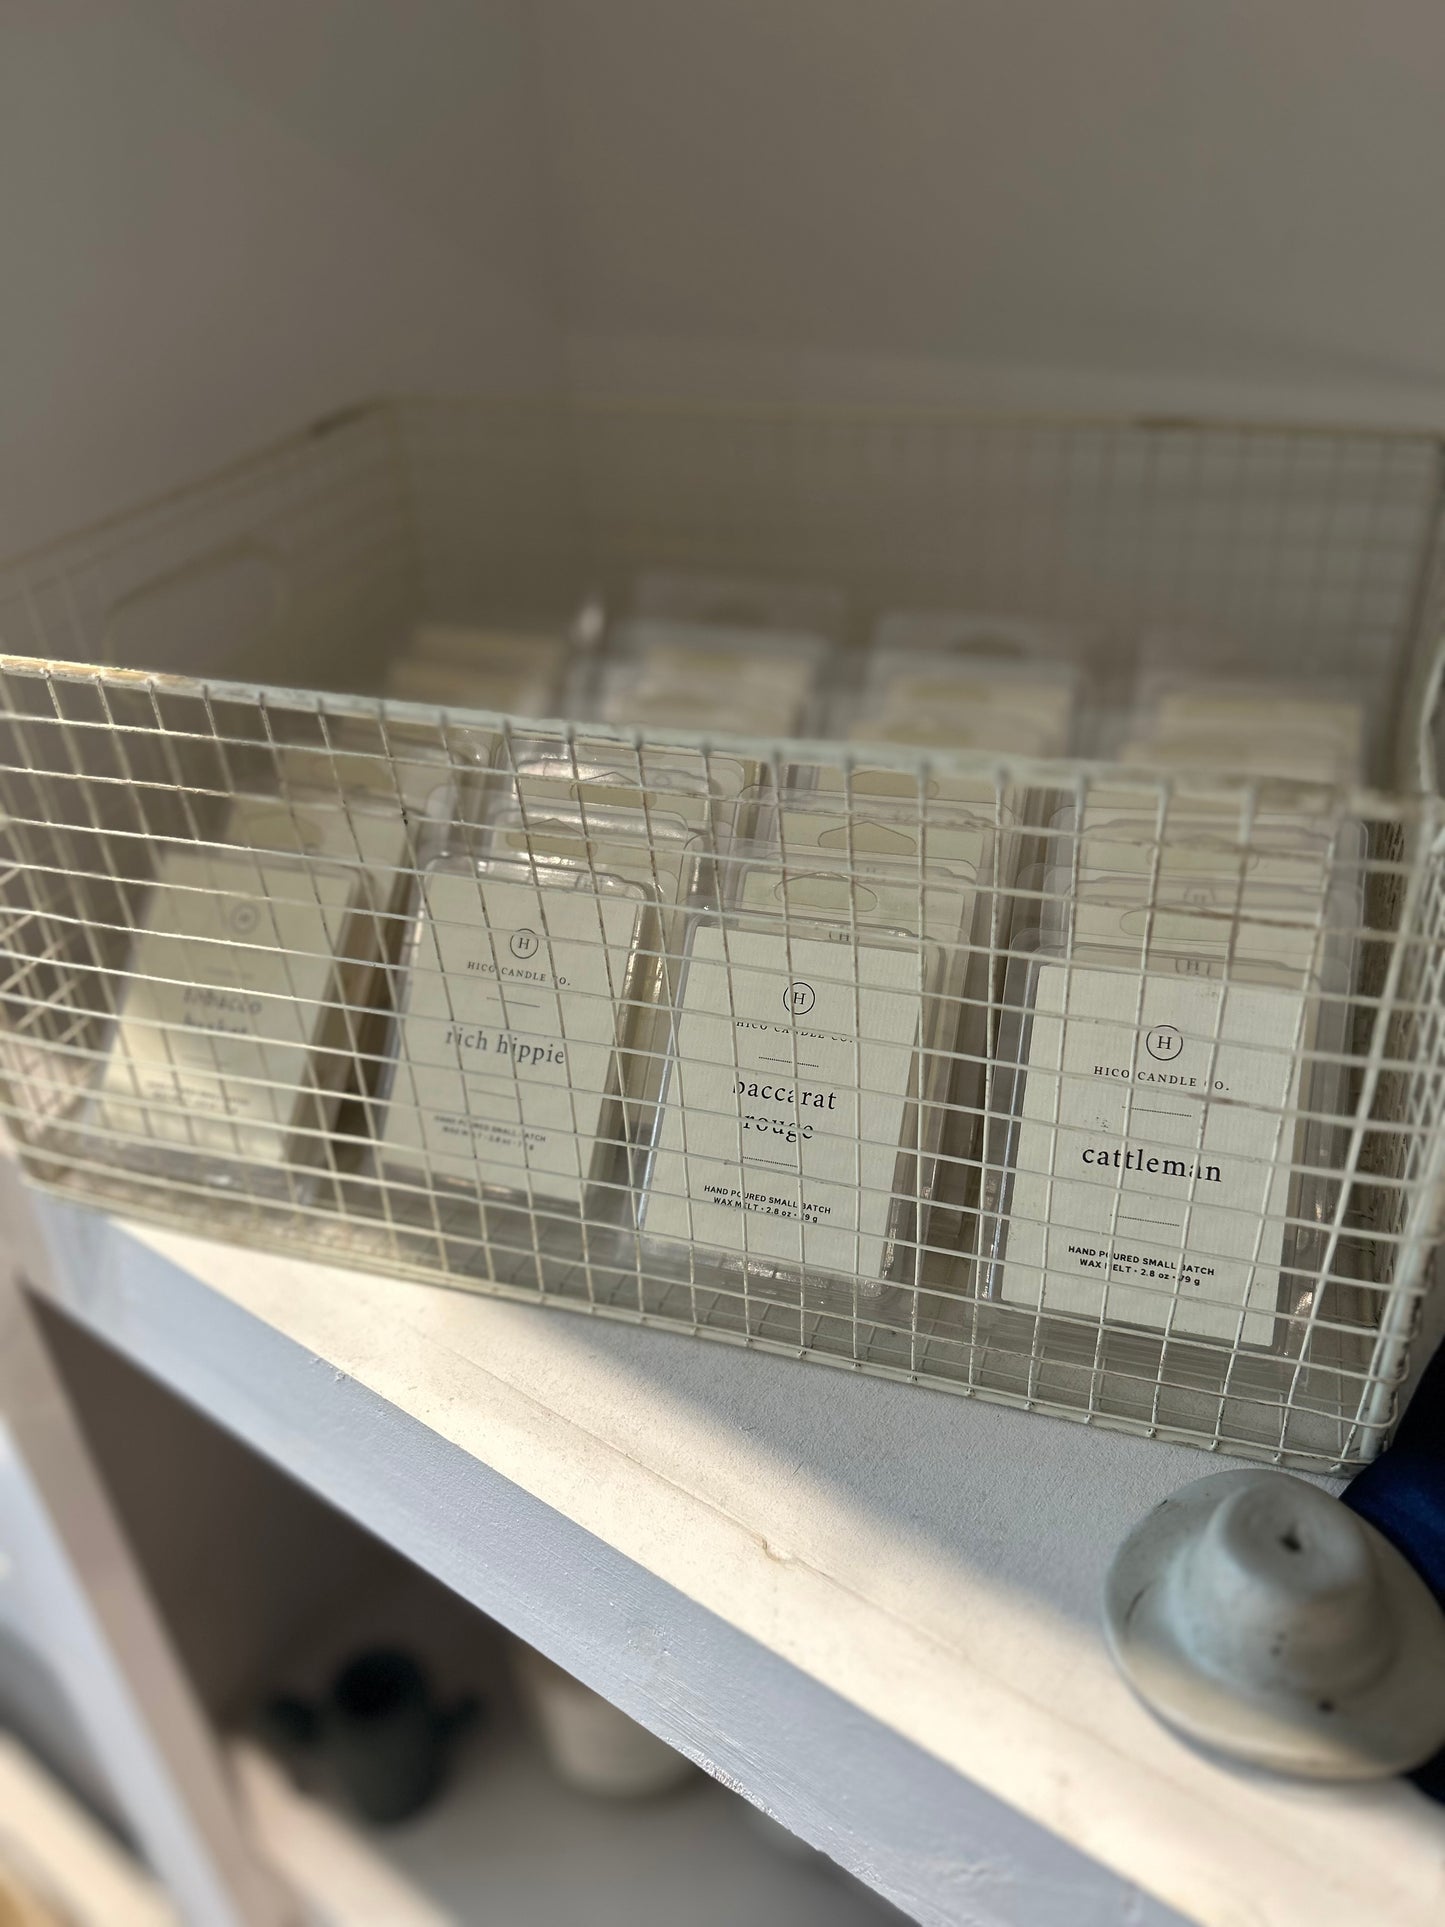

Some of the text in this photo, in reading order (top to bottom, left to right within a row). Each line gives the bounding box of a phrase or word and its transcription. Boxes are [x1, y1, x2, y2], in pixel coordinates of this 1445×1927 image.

[467, 961, 571, 986] HICO CANDLE O.
[445, 1027, 565, 1066] rich hippie
[1094, 1065, 1230, 1091] HICO CANDLE O.
[522, 1131, 546, 1142] ATCH
[1082, 1148, 1222, 1182] cattleman
[704, 1185, 729, 1195] HAND
[730, 1190, 767, 1203] POURED
[768, 1196, 798, 1209] SMALL
[713, 1197, 733, 1207] WAX
[766, 1206, 780, 1215] 2.8
[781, 1210, 792, 1218] oz
[1068, 1245, 1097, 1257] HAND
[1142, 1257, 1177, 1271] SMALL
[1079, 1258, 1102, 1269] WAX
[1104, 1262, 1132, 1274] ELT
[1140, 1268, 1155, 1278] 2.8
[1158, 1272, 1170, 1280] oz
